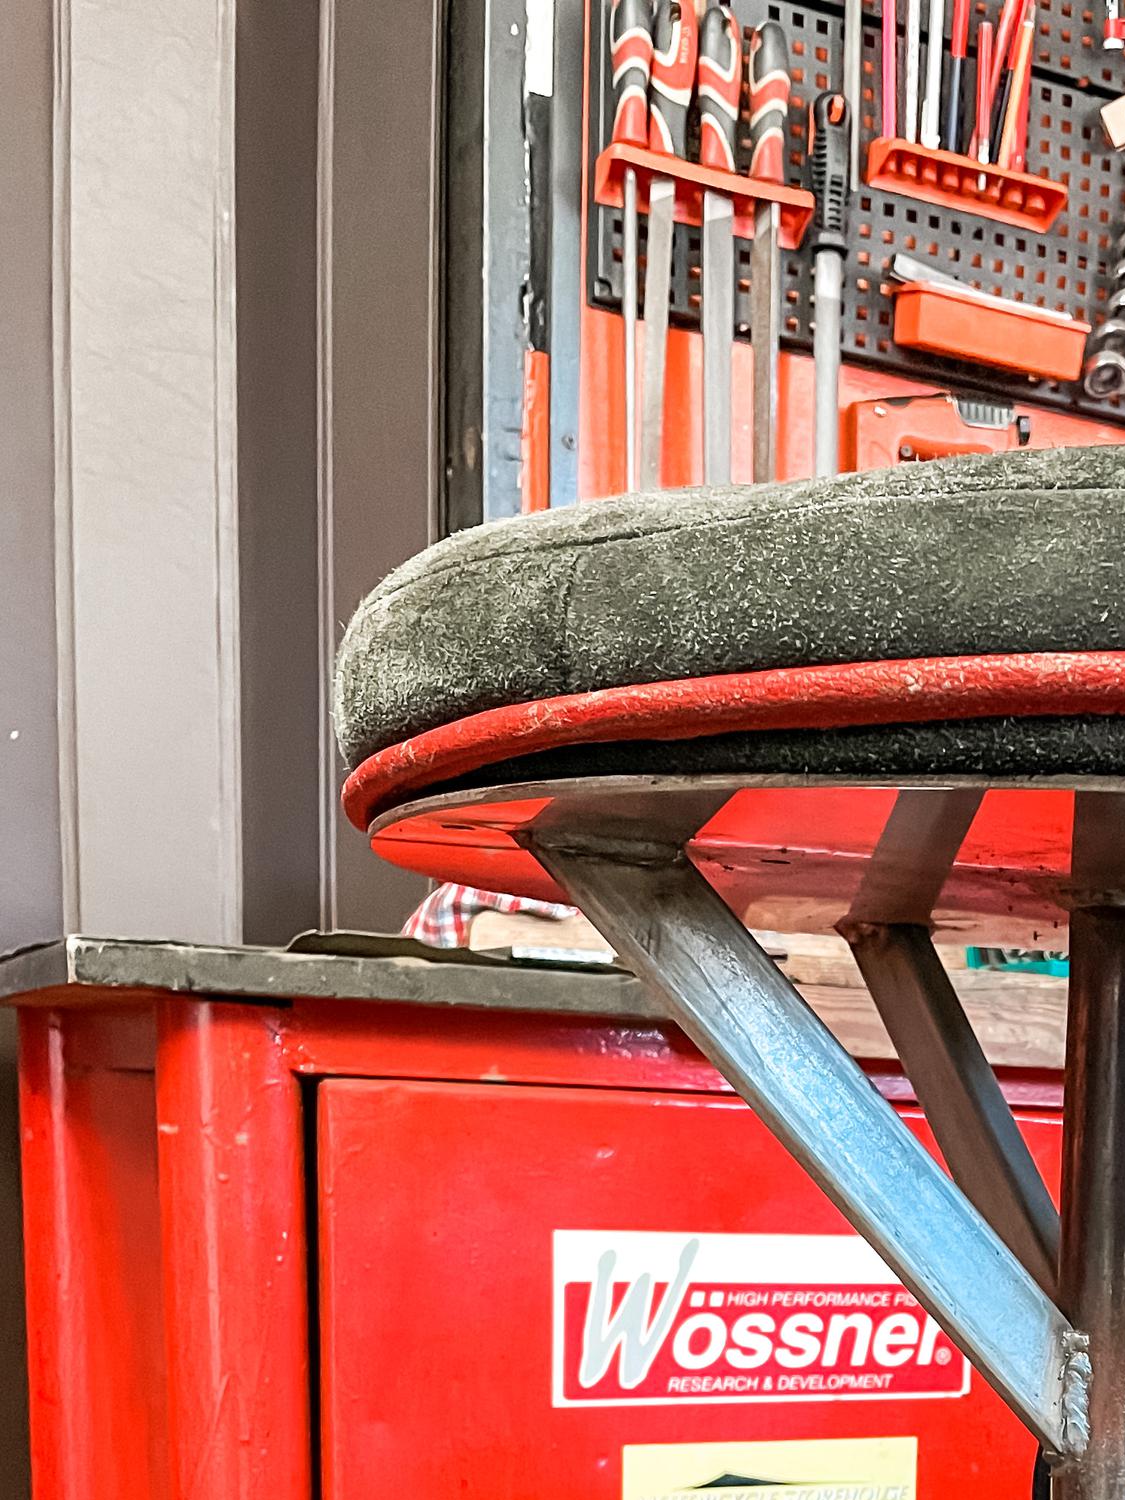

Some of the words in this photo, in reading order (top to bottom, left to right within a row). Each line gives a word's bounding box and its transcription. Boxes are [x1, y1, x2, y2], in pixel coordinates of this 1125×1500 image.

[727, 1291, 770, 1307] HIGH
[771, 1291, 890, 1307] PERFORMANCE
[667, 1375, 758, 1393] RESEARCH
[763, 1376, 772, 1391] &
[777, 1373, 893, 1391] DEVELOPMENT
